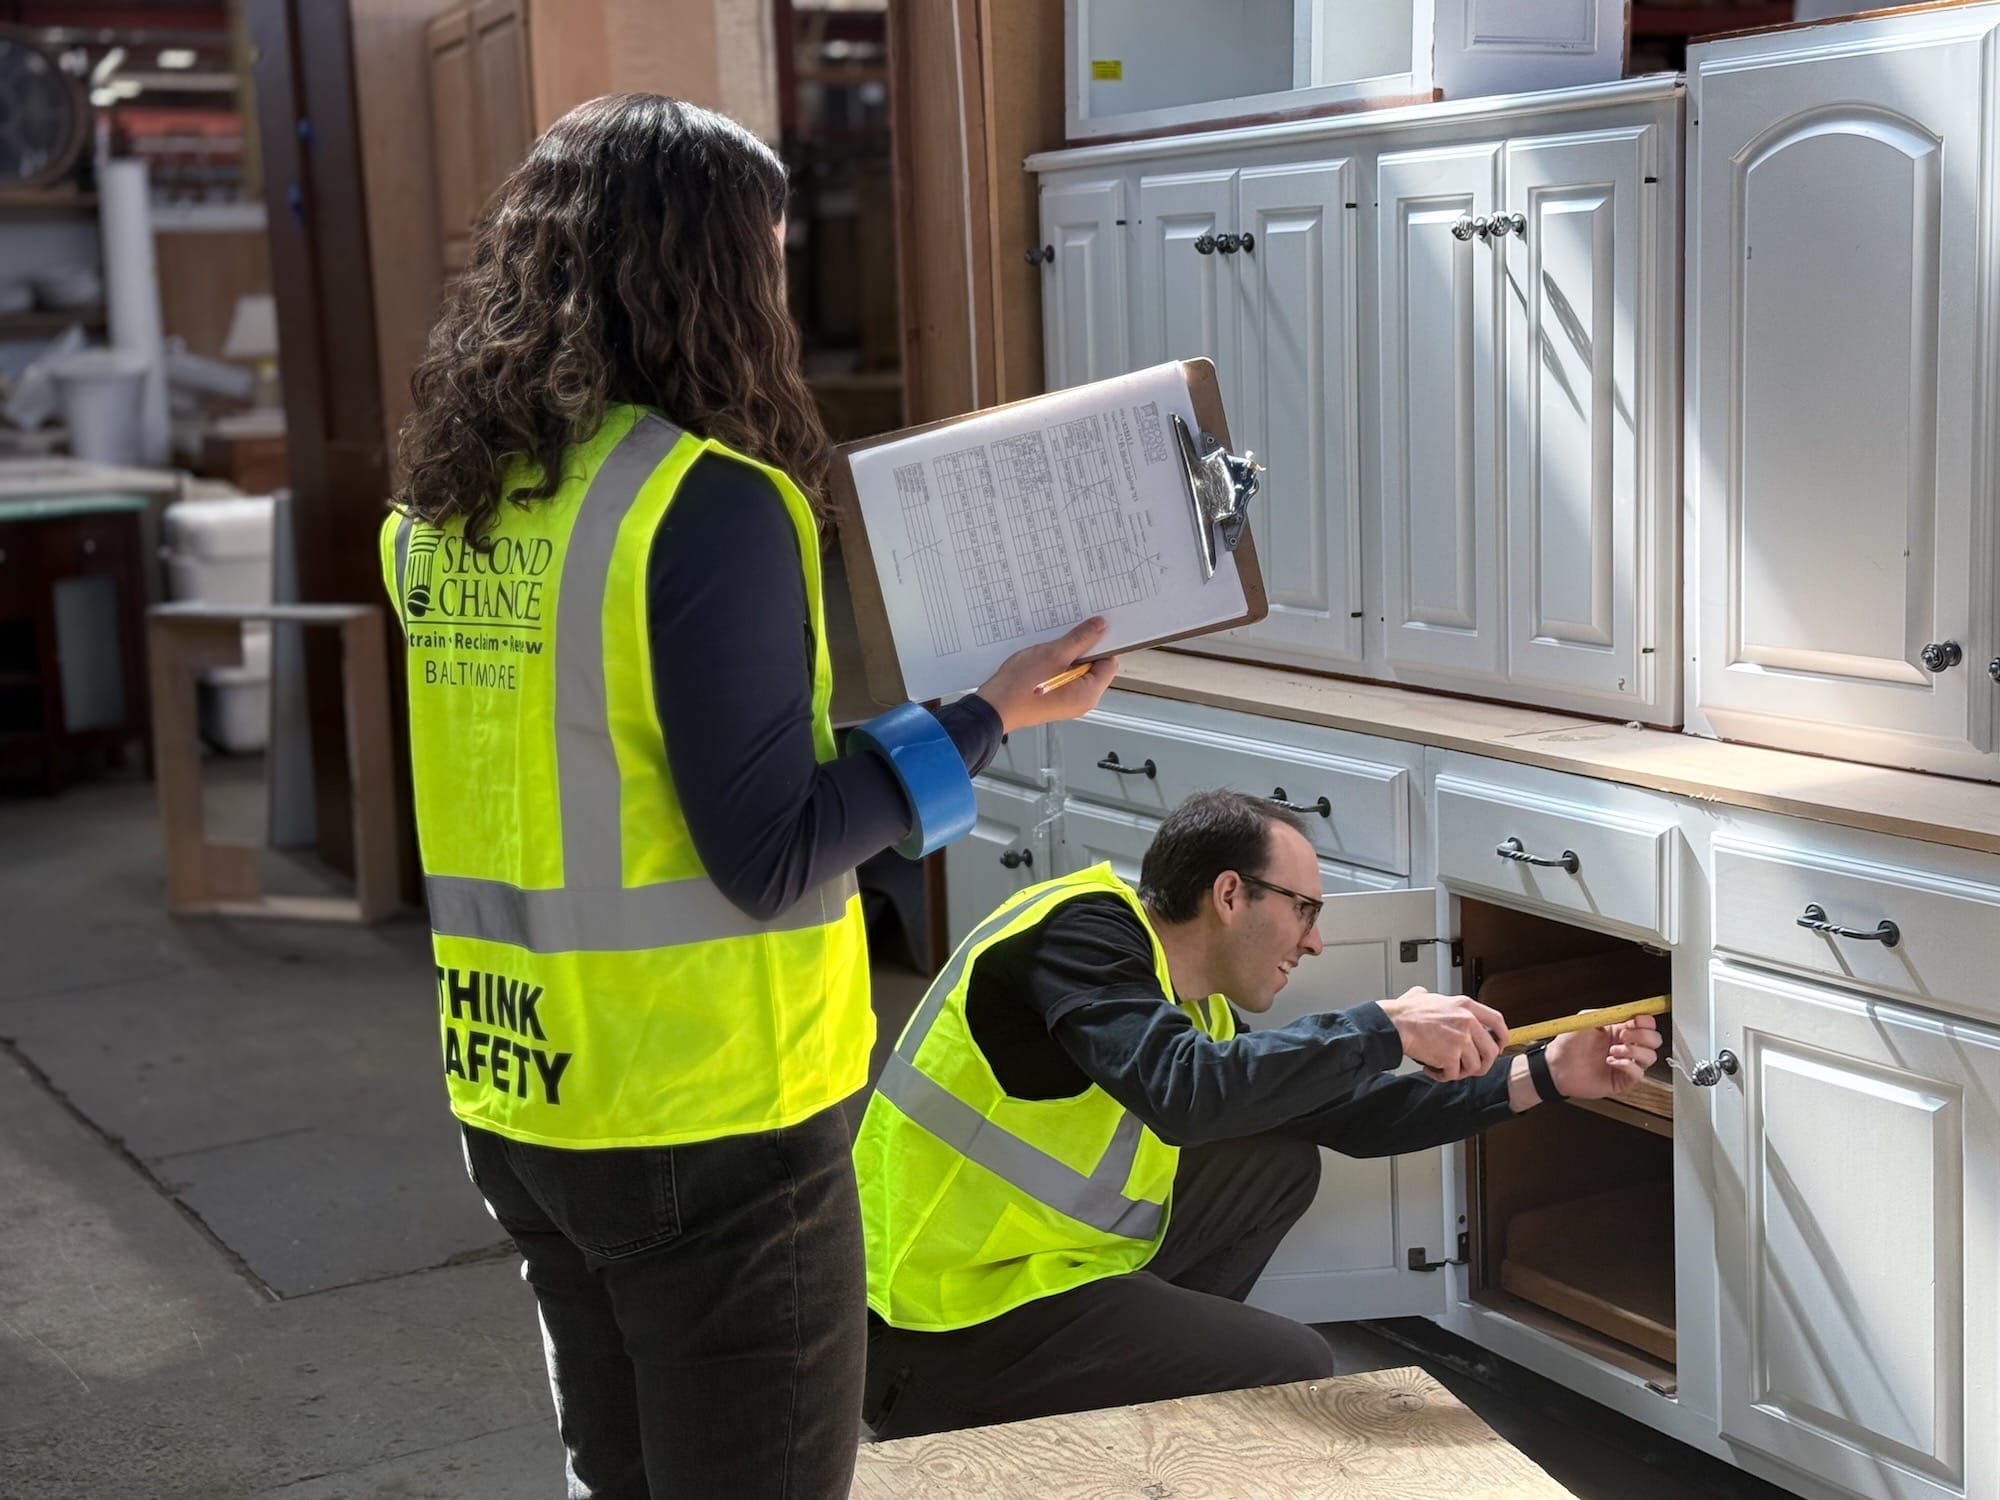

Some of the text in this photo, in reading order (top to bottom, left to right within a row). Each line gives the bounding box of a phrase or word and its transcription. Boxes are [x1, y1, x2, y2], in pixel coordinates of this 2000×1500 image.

[442, 536, 553, 576] SECOND
[438, 578, 542, 621] CHANCE
[455, 632, 499, 651] Reclaim
[425, 660, 516, 690] BALTIMORE
